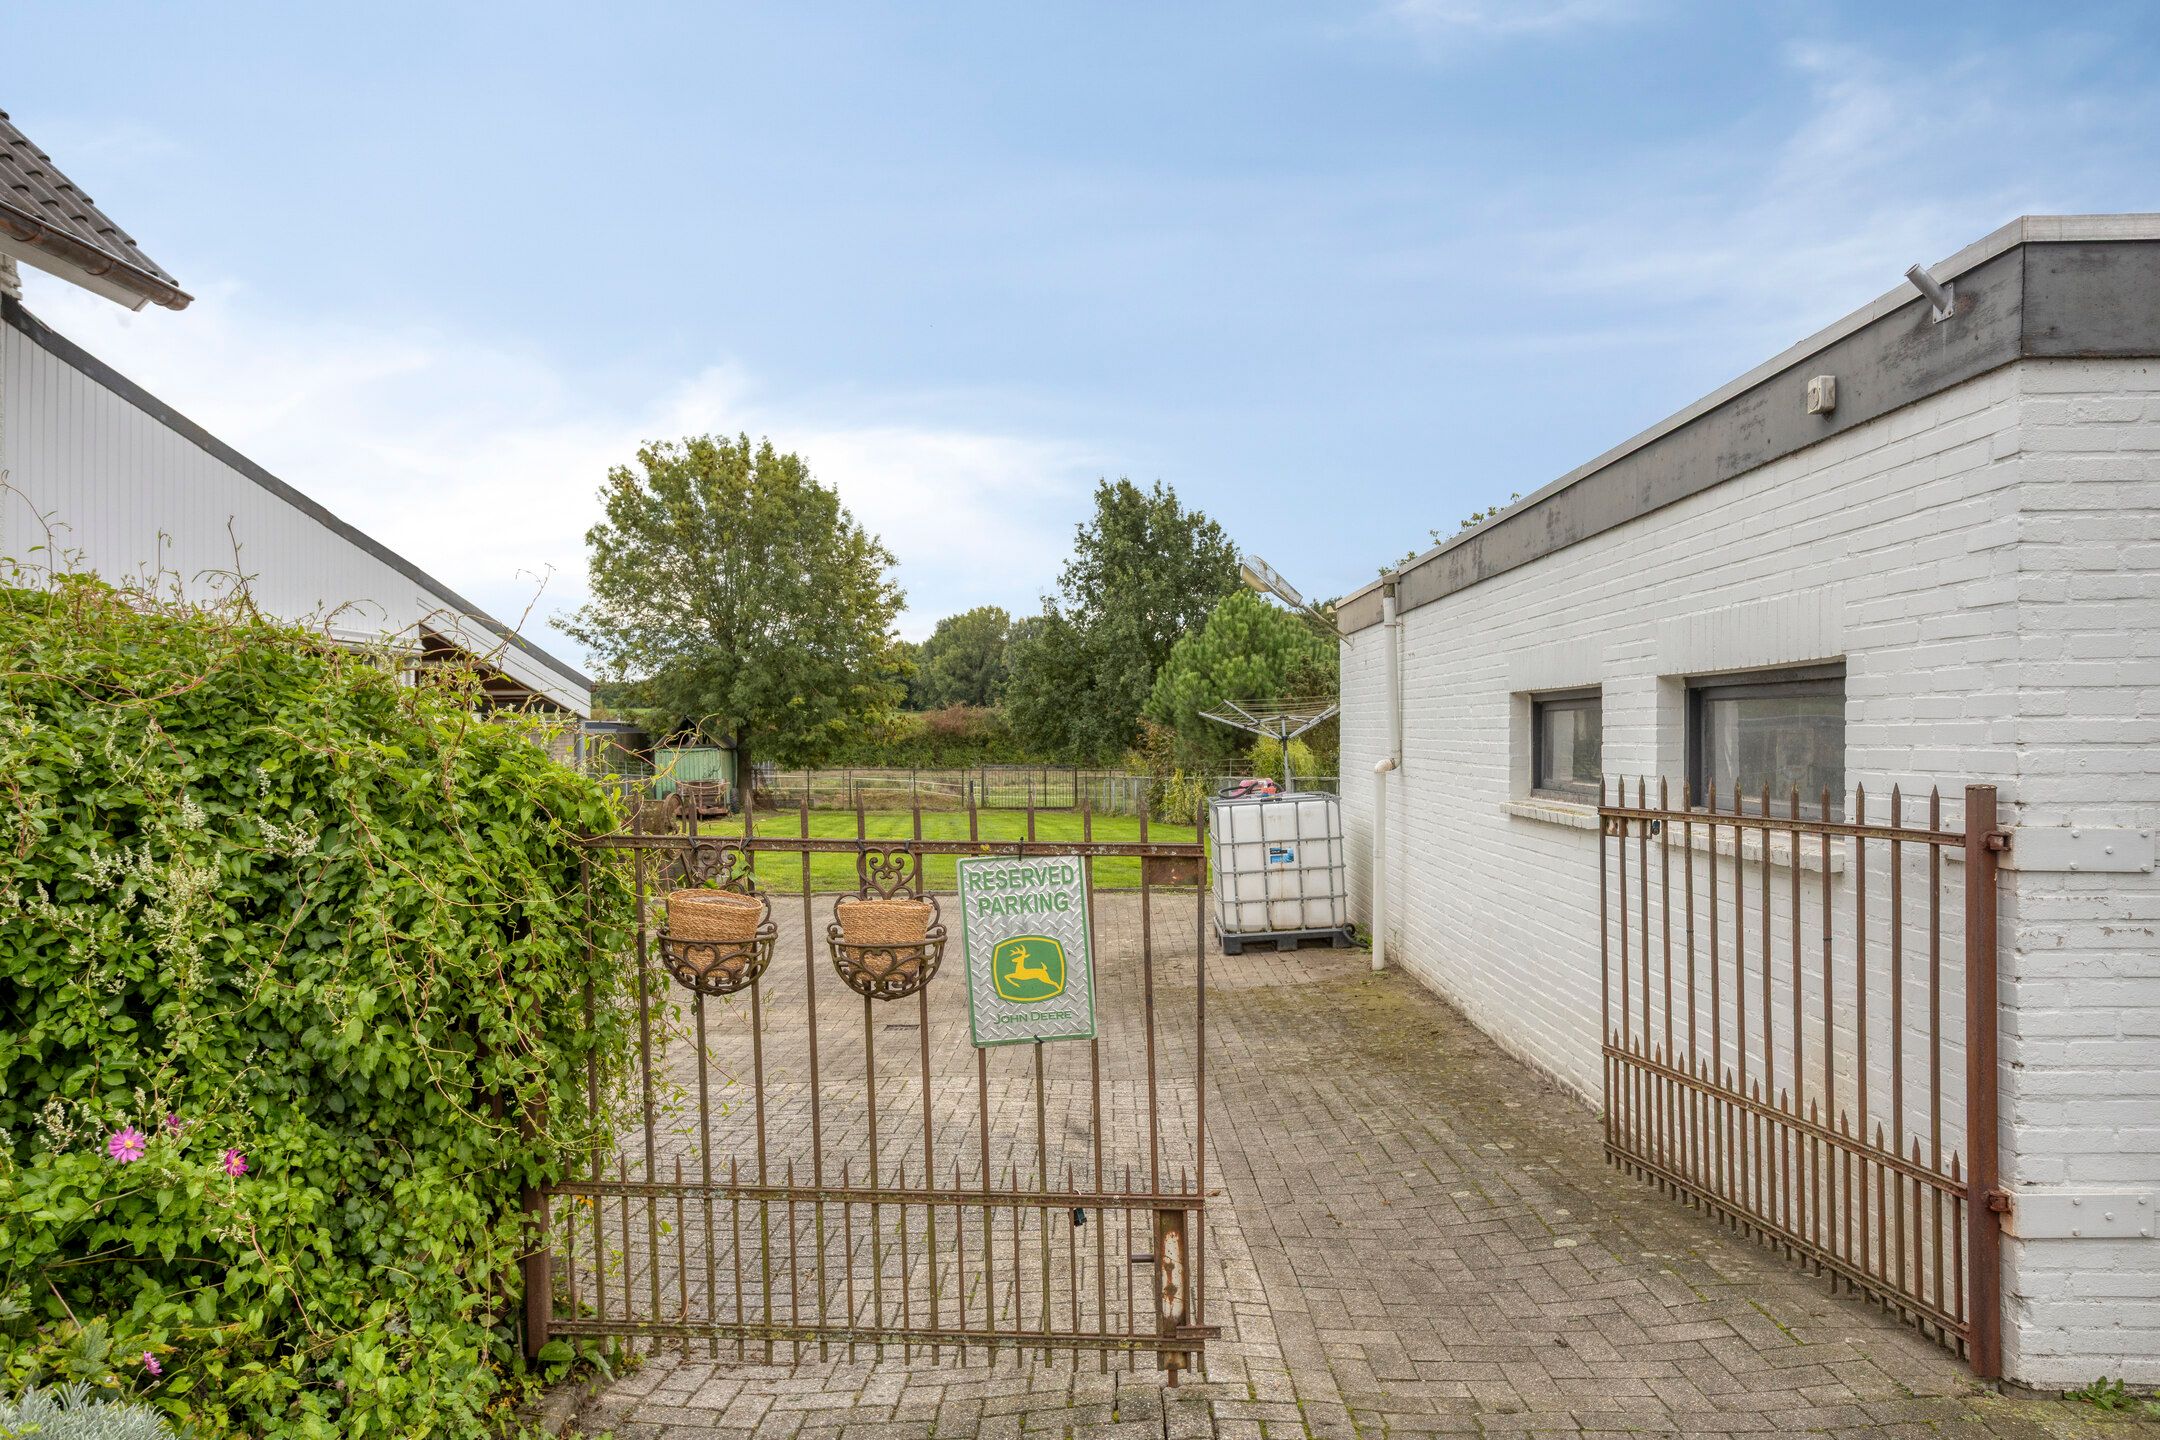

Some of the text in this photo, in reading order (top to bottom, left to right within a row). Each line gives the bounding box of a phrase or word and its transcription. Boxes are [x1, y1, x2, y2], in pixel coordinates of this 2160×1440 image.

[968, 865, 1075, 892] RESERVED
[977, 892, 1070, 917] PARKING
[993, 1010, 1073, 1025] JOHN DEERE
